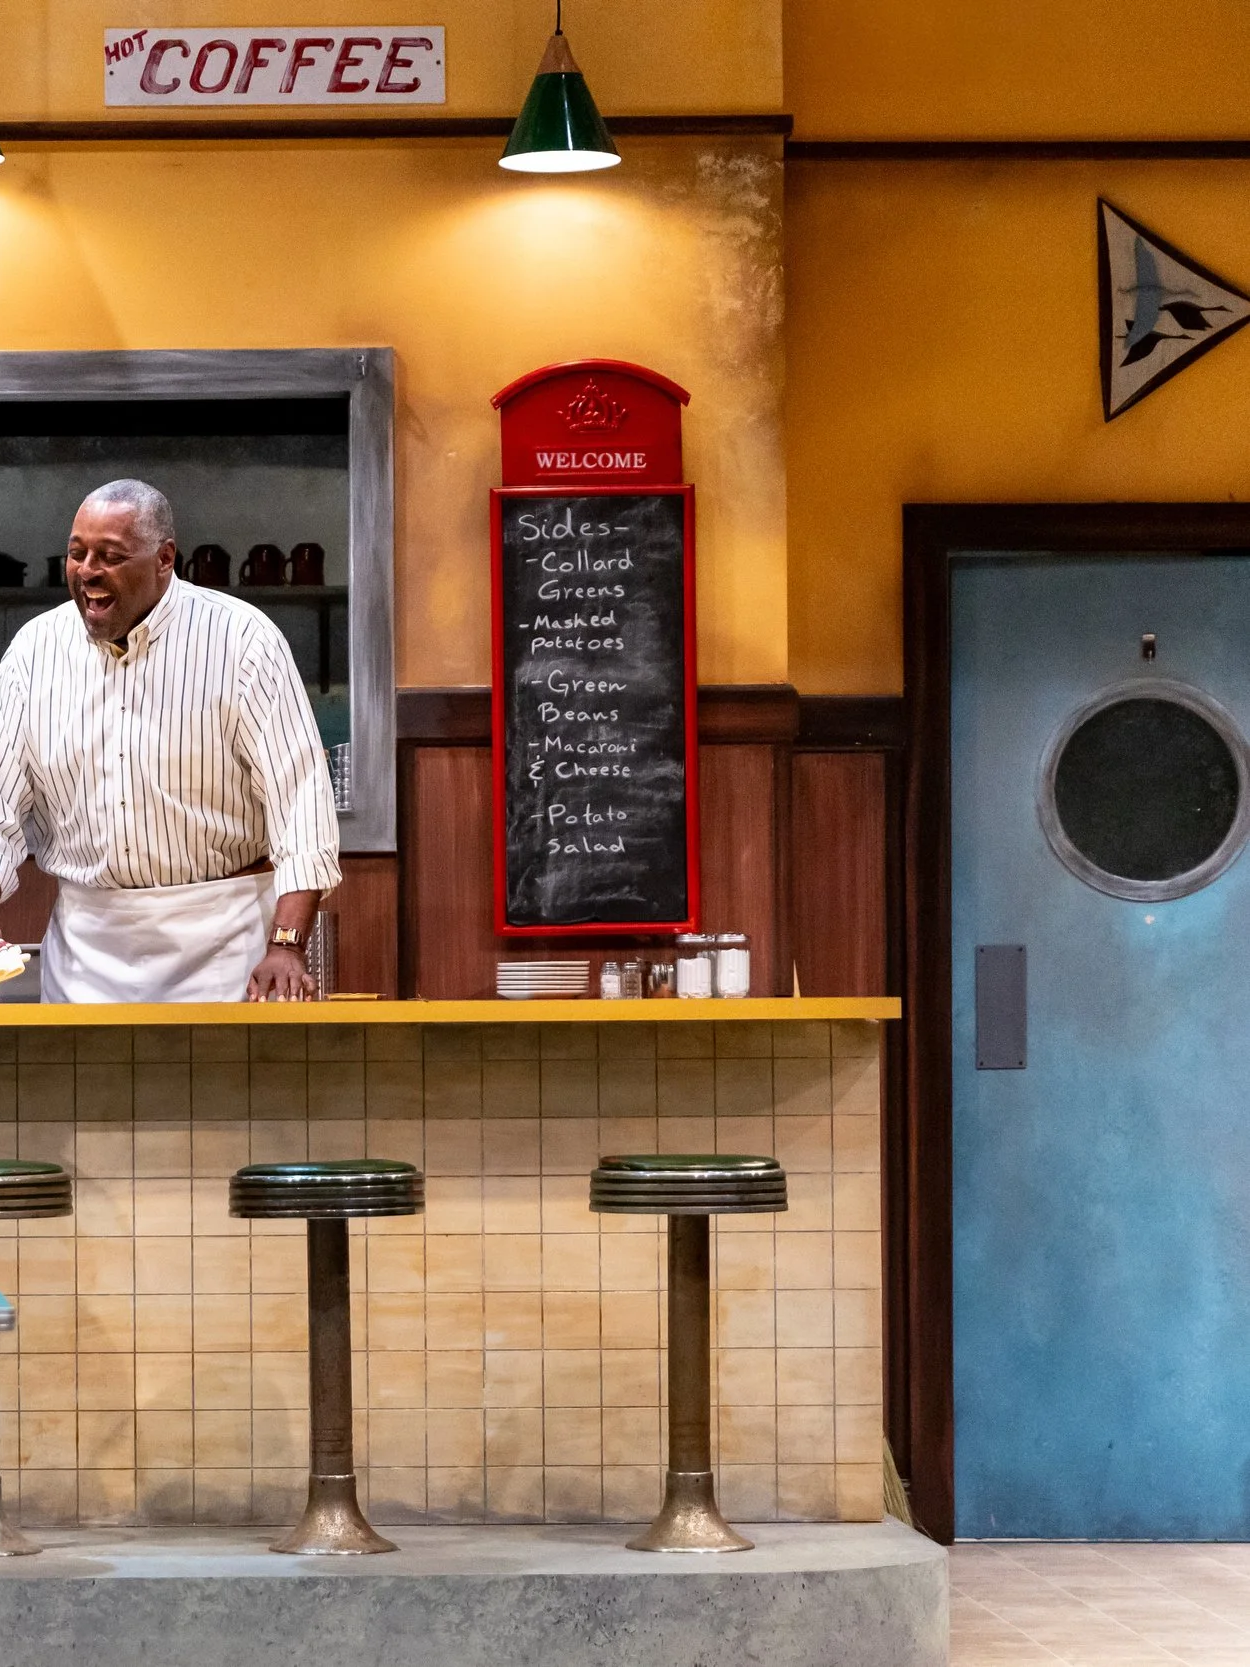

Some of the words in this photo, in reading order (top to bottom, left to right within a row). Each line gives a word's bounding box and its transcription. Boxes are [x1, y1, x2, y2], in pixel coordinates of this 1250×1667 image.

[104, 29, 148, 65] HOT
[139, 37, 434, 95] COFFEE
[536, 451, 648, 470] WELCOME
[537, 579, 626, 601] Greens
[537, 702, 619, 723] Beans
[528, 754, 546, 788] &
[555, 761, 631, 779] Cheese
